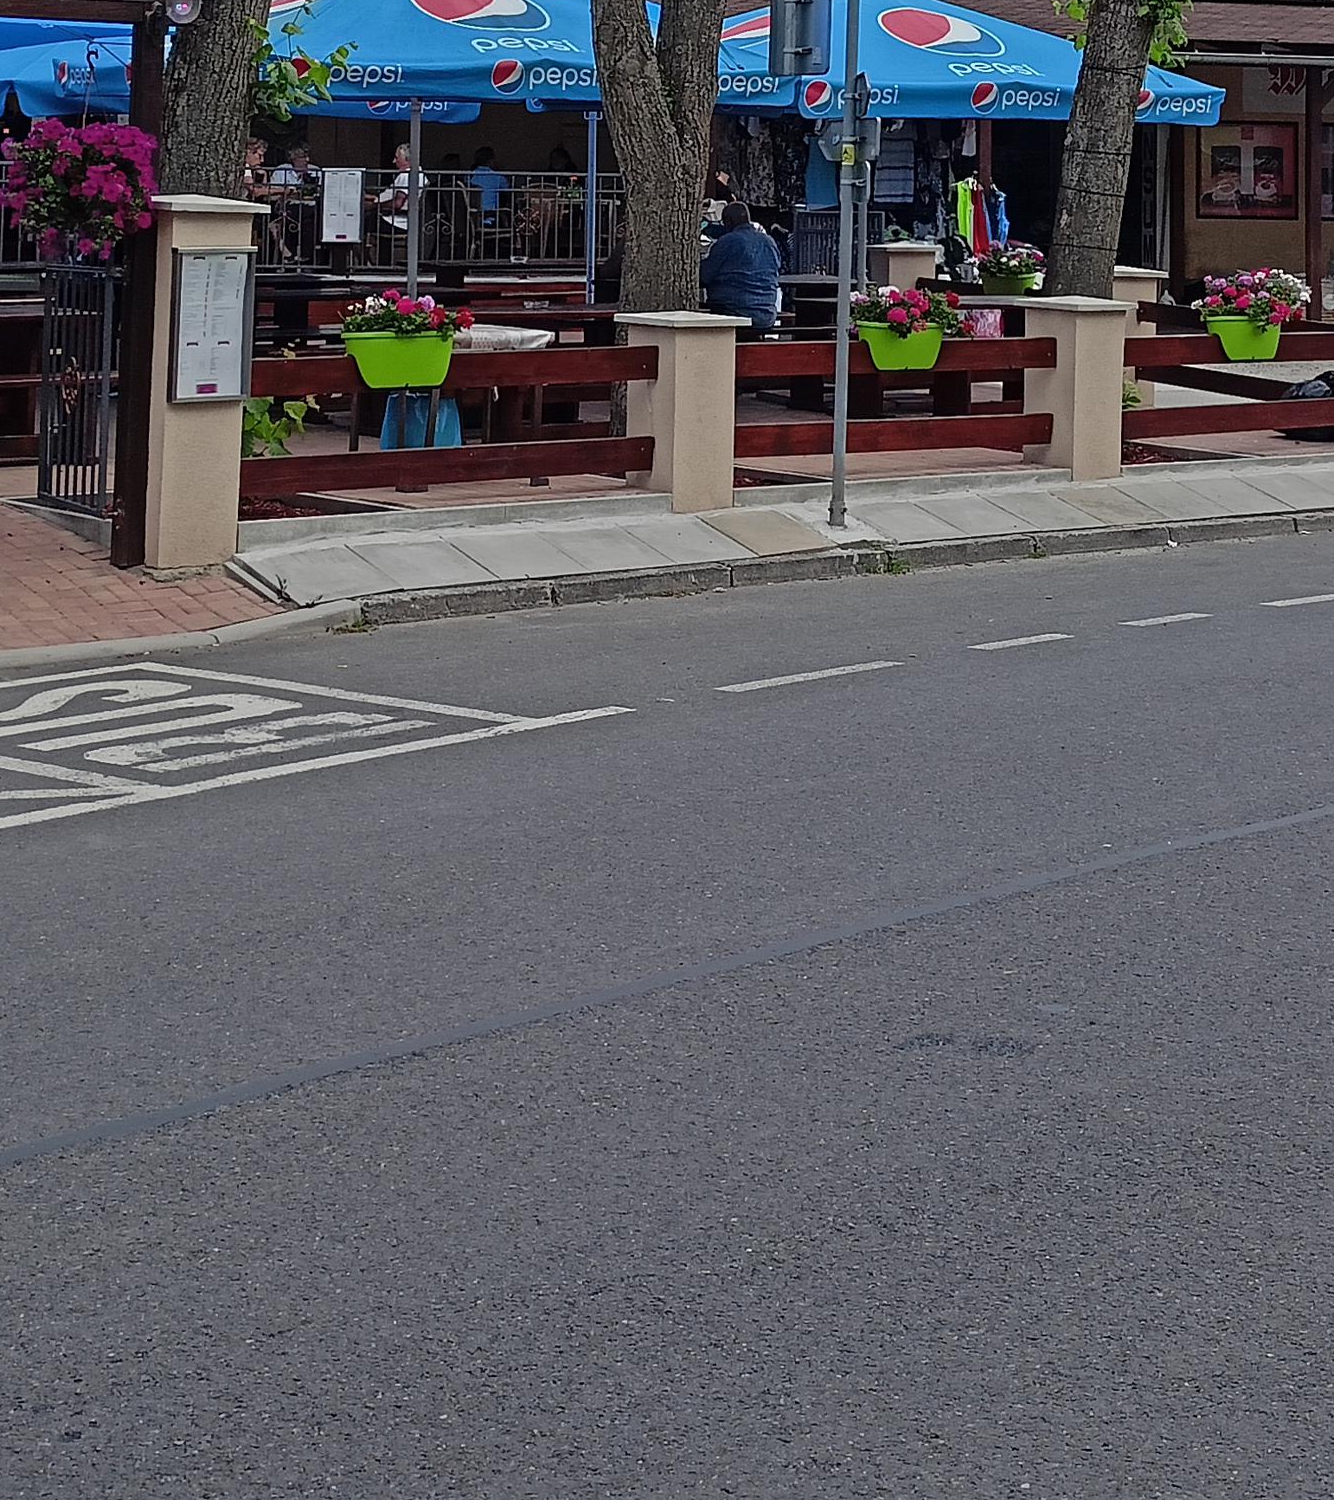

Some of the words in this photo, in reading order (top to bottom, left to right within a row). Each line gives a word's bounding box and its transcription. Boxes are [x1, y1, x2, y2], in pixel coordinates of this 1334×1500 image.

[471, 37, 580, 54] pepsi
[327, 63, 402, 88] pepsi
[529, 66, 598, 88] pepsi
[947, 61, 1044, 77] pepsi
[717, 74, 780, 97] pepsi
[837, 84, 900, 110] ppsi
[1001, 88, 1061, 111] pepsi
[1156, 95, 1213, 116] pepsi
